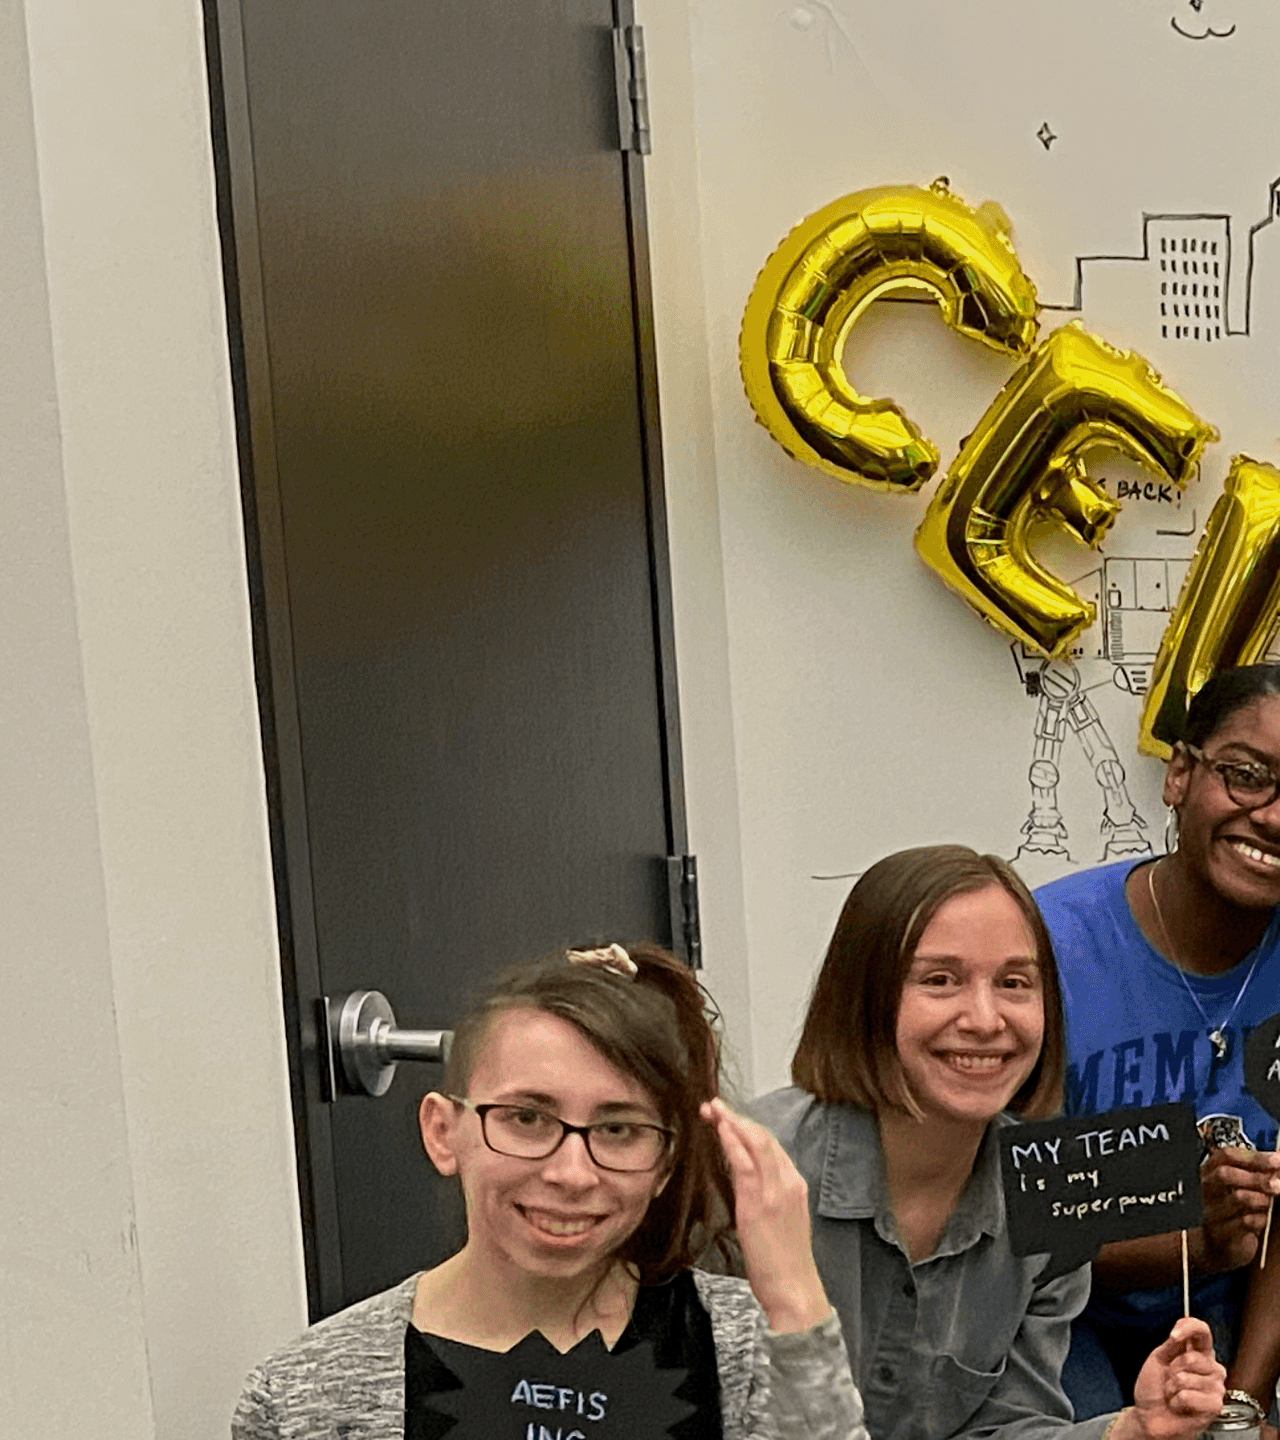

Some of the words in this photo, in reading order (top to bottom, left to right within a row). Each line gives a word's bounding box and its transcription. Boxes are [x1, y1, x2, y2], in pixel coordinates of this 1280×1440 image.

[1065, 1027, 1250, 1116] MEMP
[1012, 1137, 1061, 1169] MY
[1076, 1123, 1170, 1158] TEAM
[1067, 1170, 1098, 1188] my
[511, 1379, 608, 1421] AEFIS
